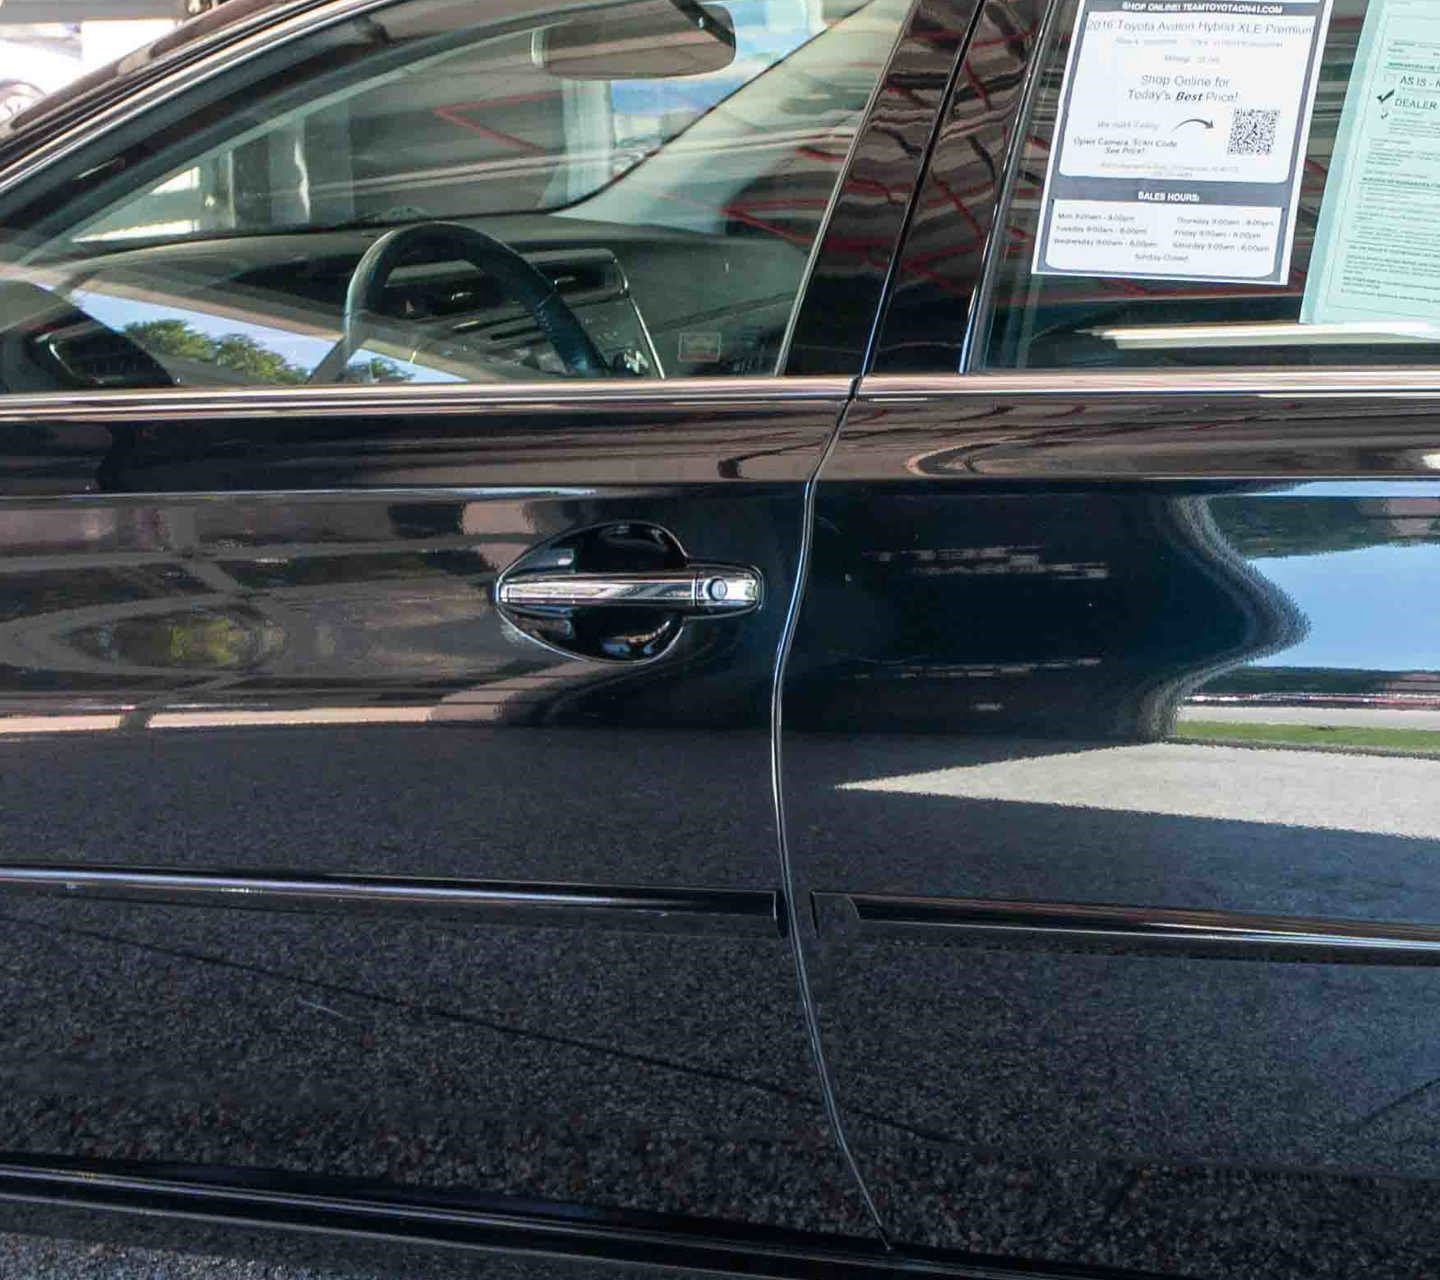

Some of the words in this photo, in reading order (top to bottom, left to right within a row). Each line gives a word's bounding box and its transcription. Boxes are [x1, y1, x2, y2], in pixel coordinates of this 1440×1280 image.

[1122, 1, 1147, 12] SHOP
[1117, 20, 1155, 34] Toyota
[1198, 22, 1234, 35] Hybrid
[1238, 23, 1262, 33] XLE
[1140, 74, 1171, 87] Shop
[1174, 76, 1211, 86] Online
[1214, 76, 1230, 87] for
[1399, 75, 1415, 86] AS
[1416, 76, 1428, 87] IS
[1127, 90, 1171, 102] Today's
[1175, 91, 1204, 101] Best
[1205, 92, 1240, 102] Price!
[1394, 98, 1438, 110] DEALER
[1138, 191, 1166, 201] SALES
[1167, 192, 1201, 202] HOURS:
